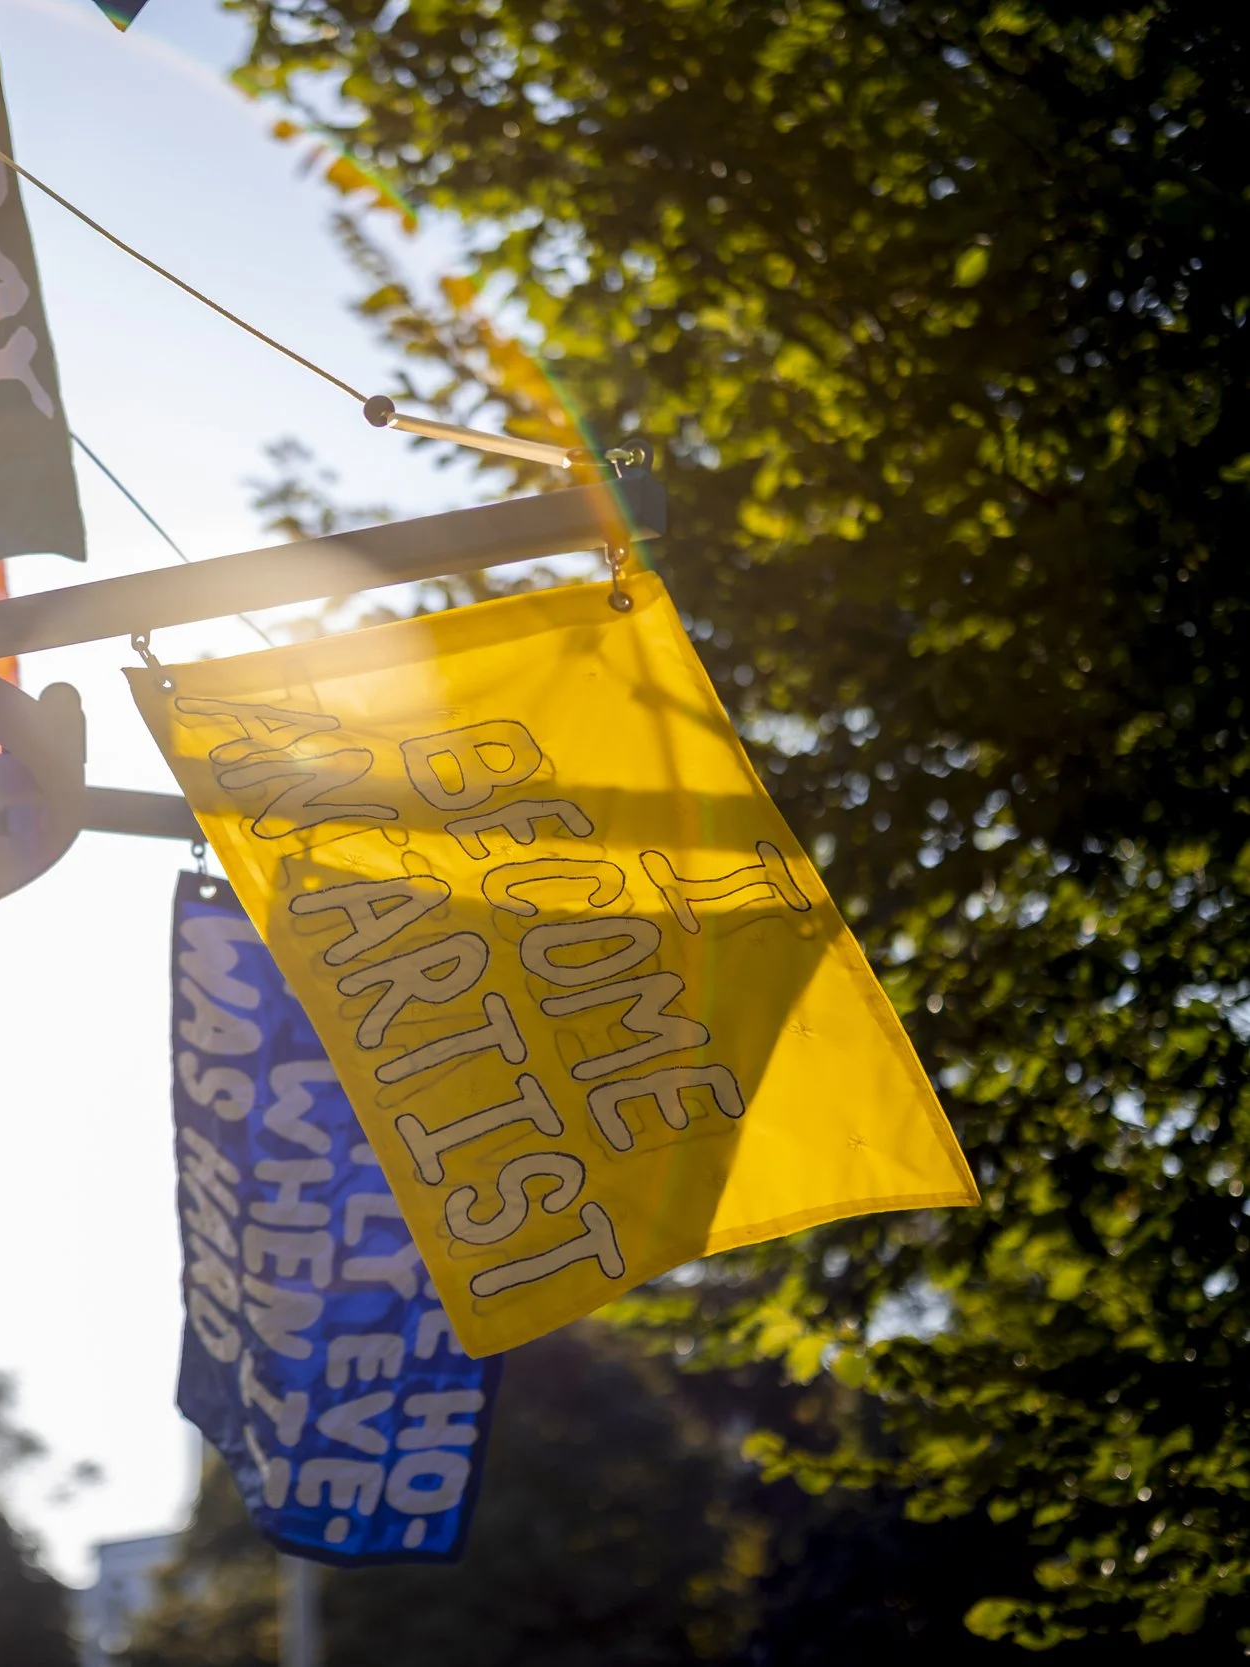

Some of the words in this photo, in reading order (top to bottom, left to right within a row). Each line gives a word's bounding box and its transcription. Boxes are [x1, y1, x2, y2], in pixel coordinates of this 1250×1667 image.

[175, 697, 398, 839] AN
[291, 875, 626, 1298] ARTIST
[179, 916, 267, 1121] WAS
[400, 719, 745, 1152] BECOME
[639, 841, 812, 935] I
[183, 1125, 242, 1363] HARD
[242, 1059, 340, 1360] WHEN
